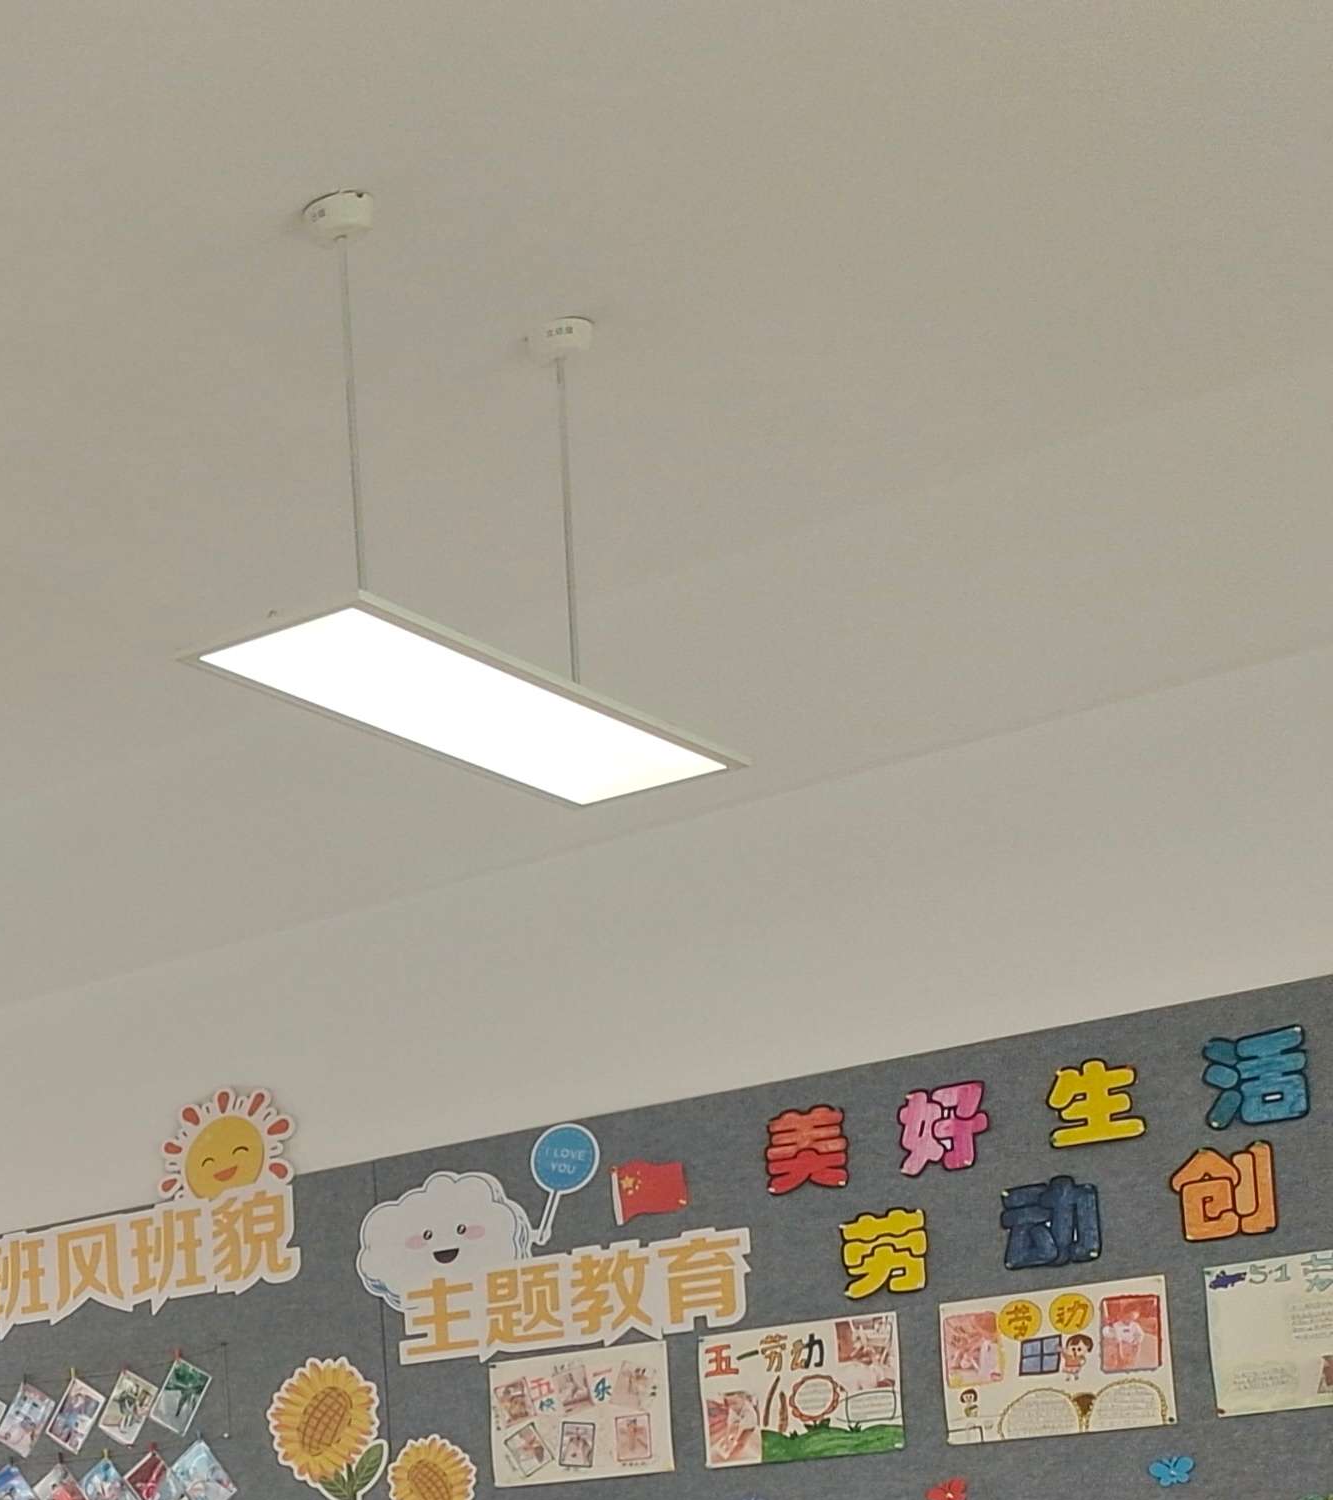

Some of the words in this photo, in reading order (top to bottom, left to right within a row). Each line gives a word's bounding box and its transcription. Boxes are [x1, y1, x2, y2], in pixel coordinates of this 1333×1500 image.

[764, 1023, 1310, 1196] 美好生活
[551, 1162, 576, 1175] YOU
[553, 1149, 587, 1162] LOVE
[406, 1236, 740, 1357] 主题教育
[1006, 1300, 1089, 1340] 劳动
